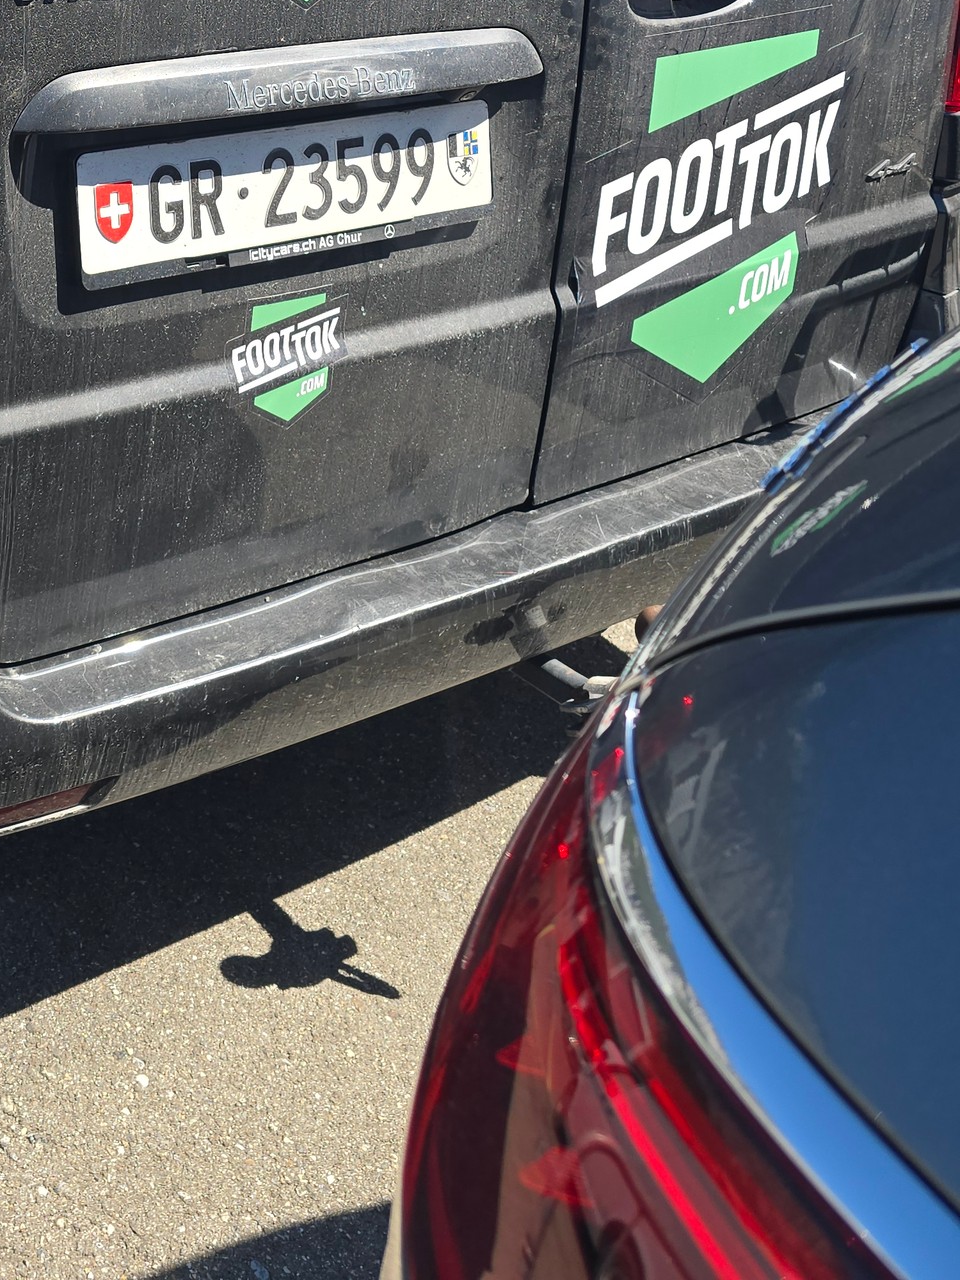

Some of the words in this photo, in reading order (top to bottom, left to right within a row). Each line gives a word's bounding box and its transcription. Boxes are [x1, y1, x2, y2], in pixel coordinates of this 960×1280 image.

[224, 67, 416, 113] Mercedes-Benz
[149, 160, 226, 244] GR
[260, 127, 435, 228] 23599
[592, 99, 841, 276] FOOTTOK
[319, 234, 334, 249] AG
[337, 231, 362, 246] Chur
[728, 250, 792, 315] .COM
[232, 321, 340, 376] FOOTTOK
[296, 375, 325, 398] .COM
